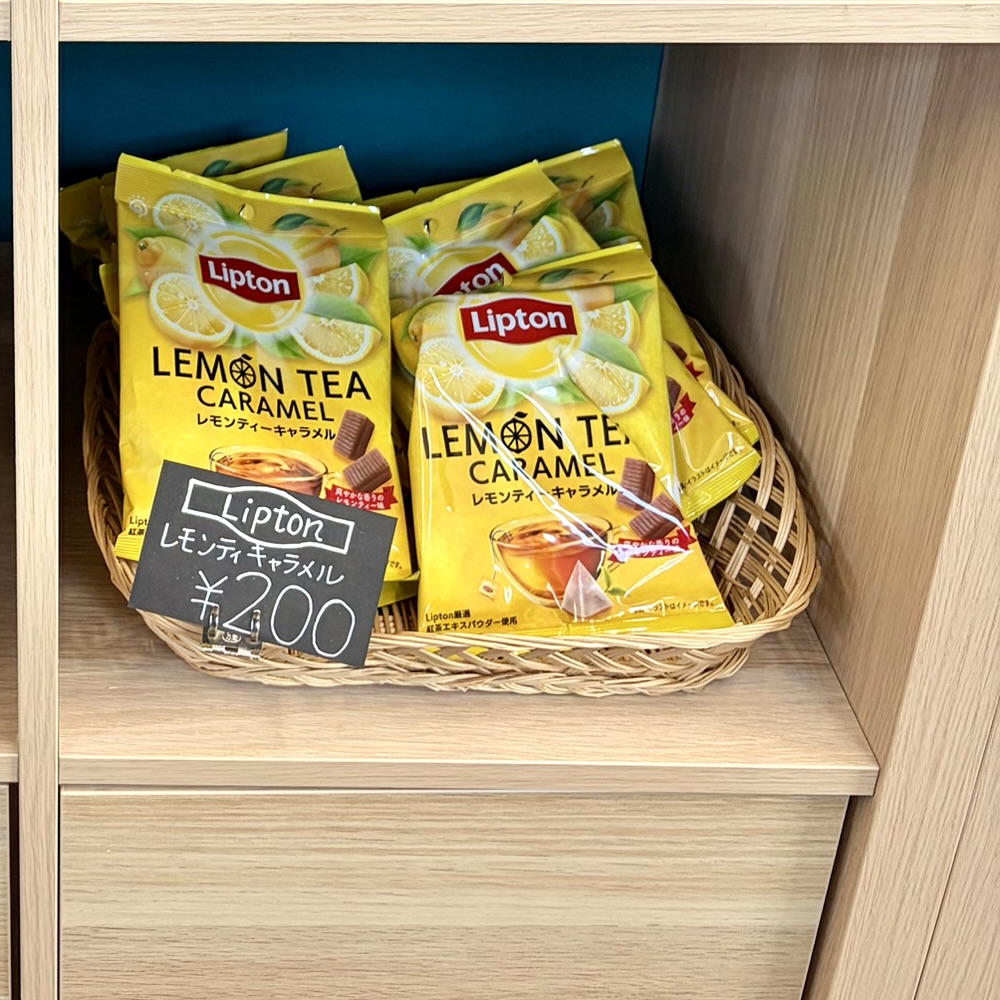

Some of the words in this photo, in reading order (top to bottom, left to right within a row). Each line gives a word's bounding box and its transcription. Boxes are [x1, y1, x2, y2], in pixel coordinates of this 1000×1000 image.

[207, 260, 291, 296] Lipton
[458, 261, 505, 296] ton
[470, 307, 568, 337] Lipton
[152, 346, 284, 395] LEMON
[296, 369, 372, 401] TEA
[197, 385, 335, 422] CARAMEL
[197, 413, 337, 441] レモンティーキャラメル
[421, 411, 565, 459] LEMON
[577, 413, 630, 448] TE
[468, 452, 616, 485] CARAMEL
[221, 493, 323, 542] Lipton
[190, 570, 356, 658] ¥200
